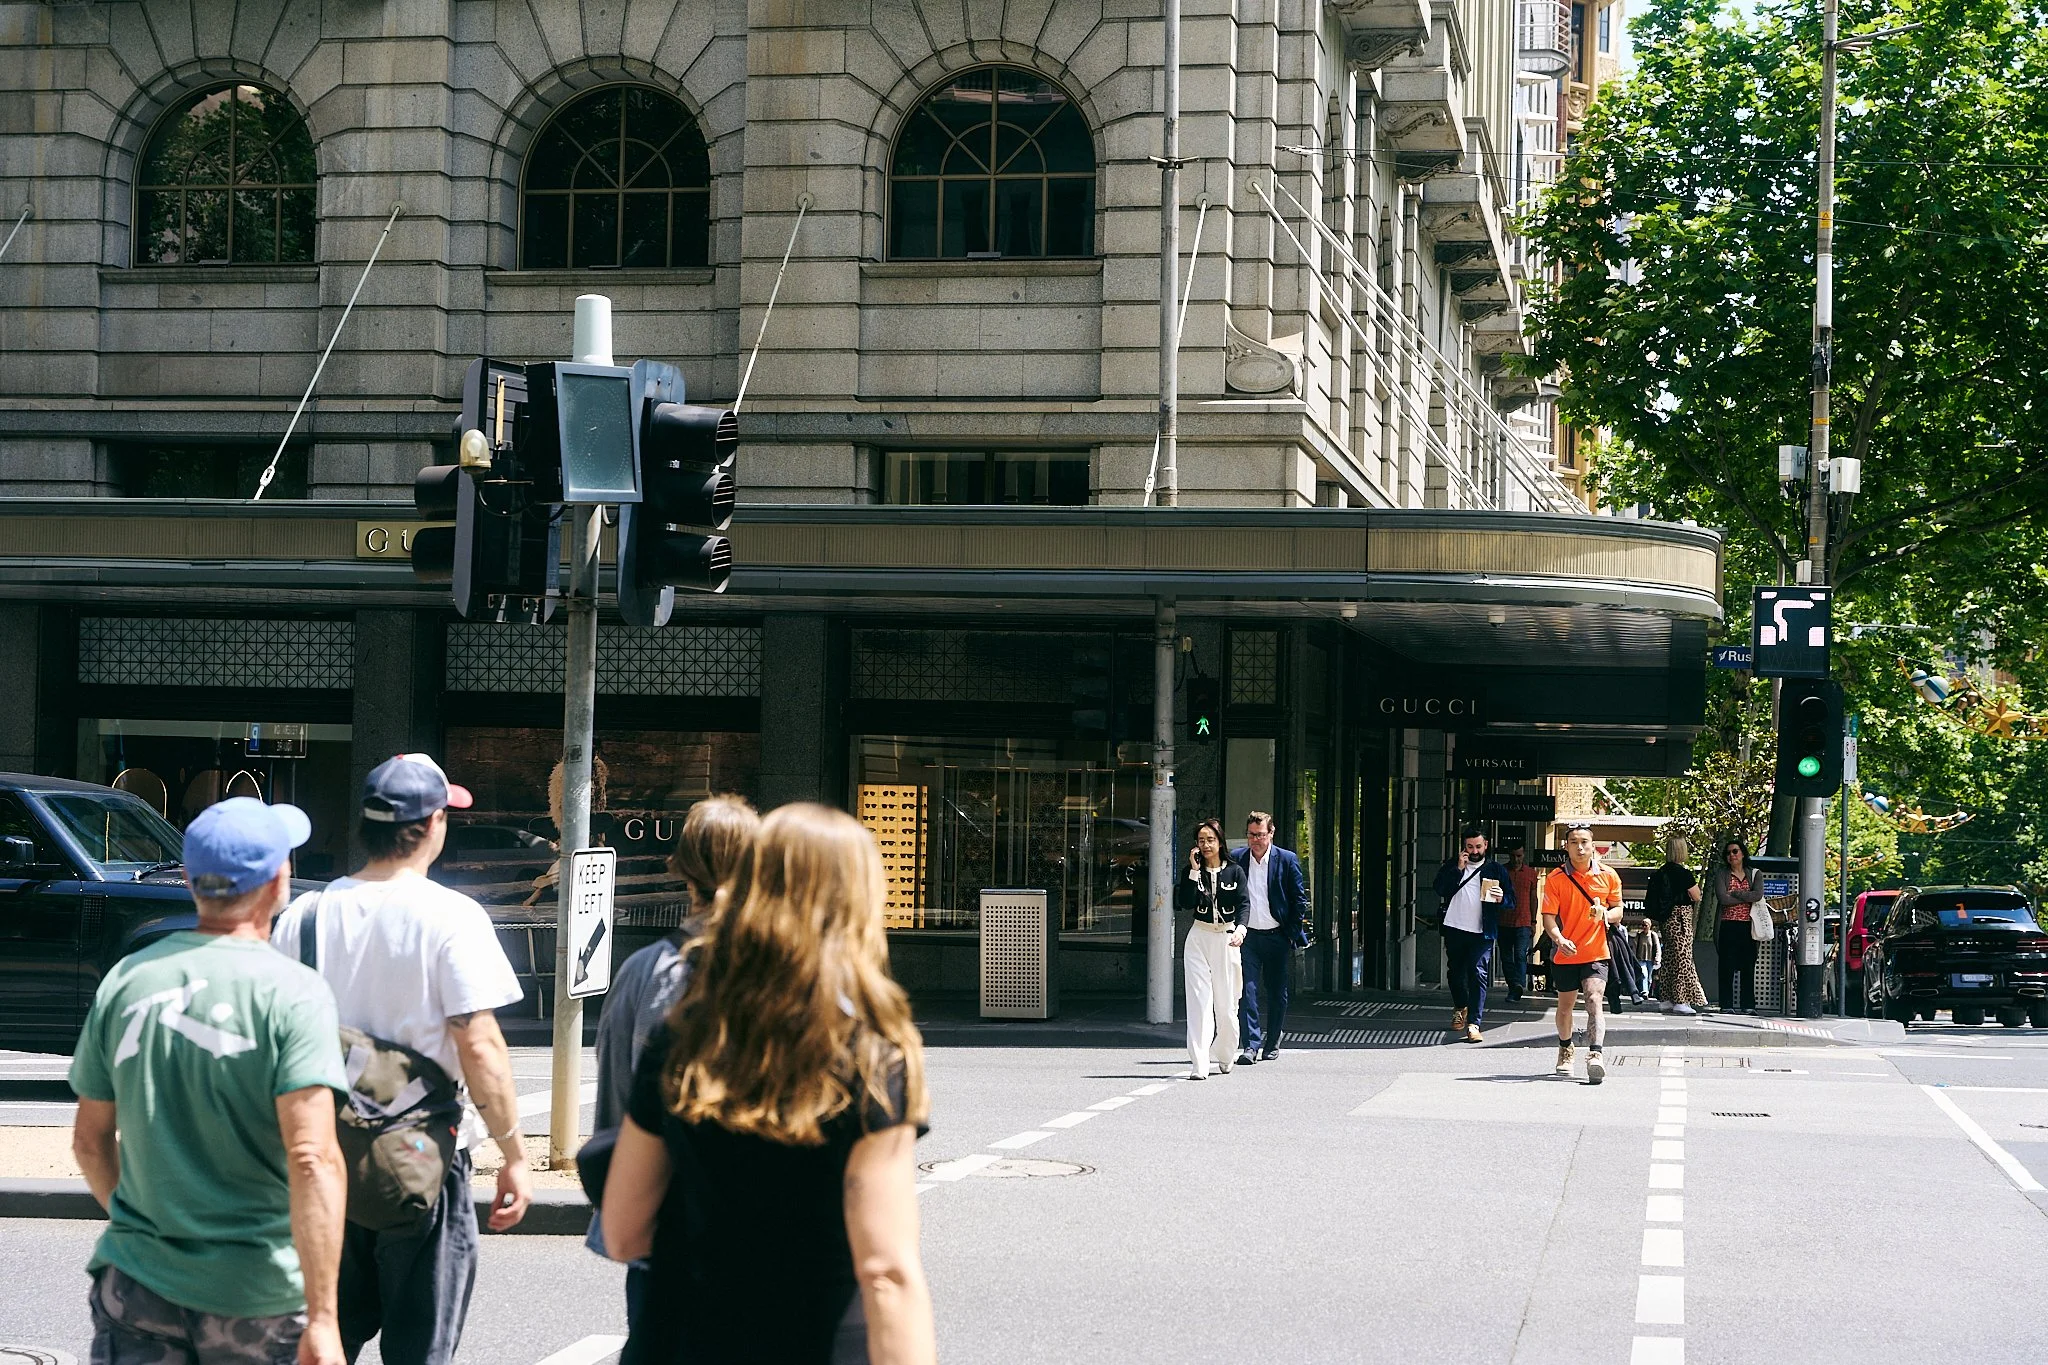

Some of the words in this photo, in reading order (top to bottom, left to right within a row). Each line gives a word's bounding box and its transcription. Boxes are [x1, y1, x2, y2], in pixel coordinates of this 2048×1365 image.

[1379, 697, 1476, 715] GUCCI
[1465, 758, 1526, 769] VERSACE
[1488, 803, 1520, 811] BOTTEGA
[1522, 804, 1549, 812] VENETA
[578, 863, 606, 884] KEEP
[578, 893, 603, 914] LEFT
